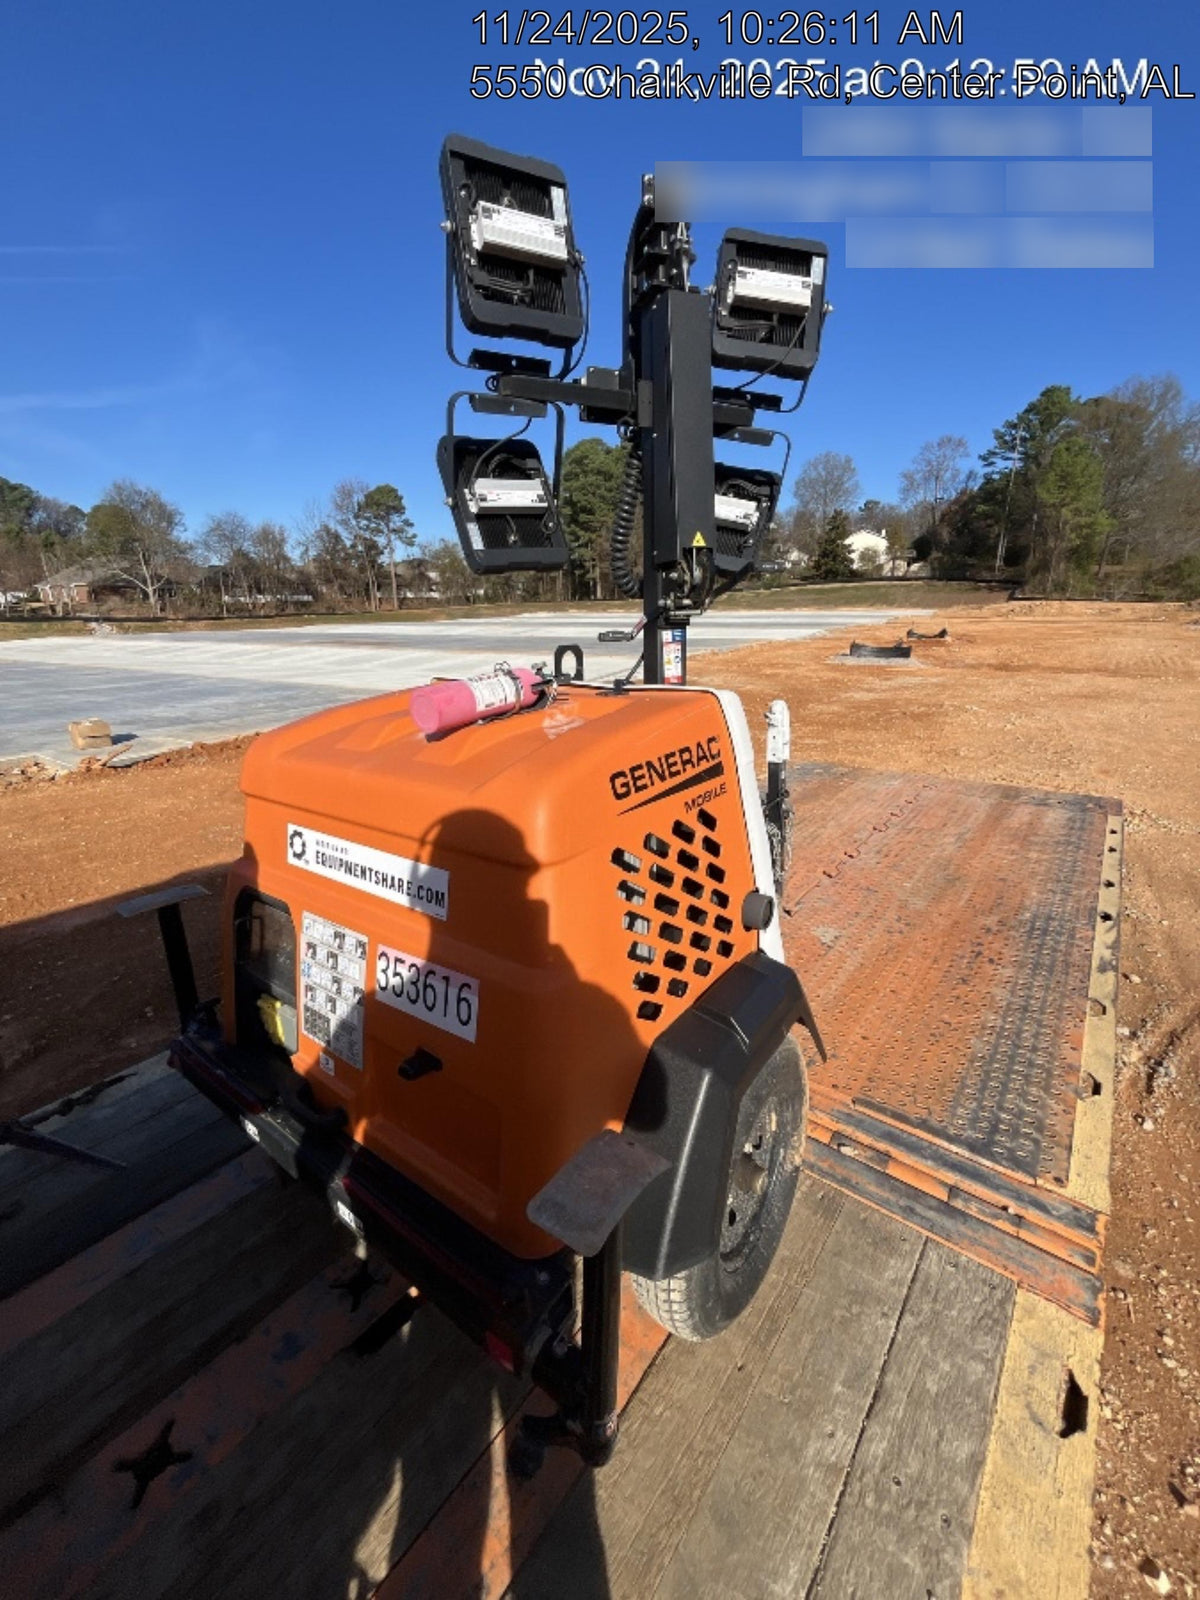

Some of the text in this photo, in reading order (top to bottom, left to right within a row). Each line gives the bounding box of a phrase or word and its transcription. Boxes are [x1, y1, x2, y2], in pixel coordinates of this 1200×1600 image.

[609, 736, 721, 801] GENERAC
[684, 782, 728, 814] MOBILE
[315, 849, 446, 909] EQUIPMENTSHARE.COM
[376, 951, 472, 1027] 353616
